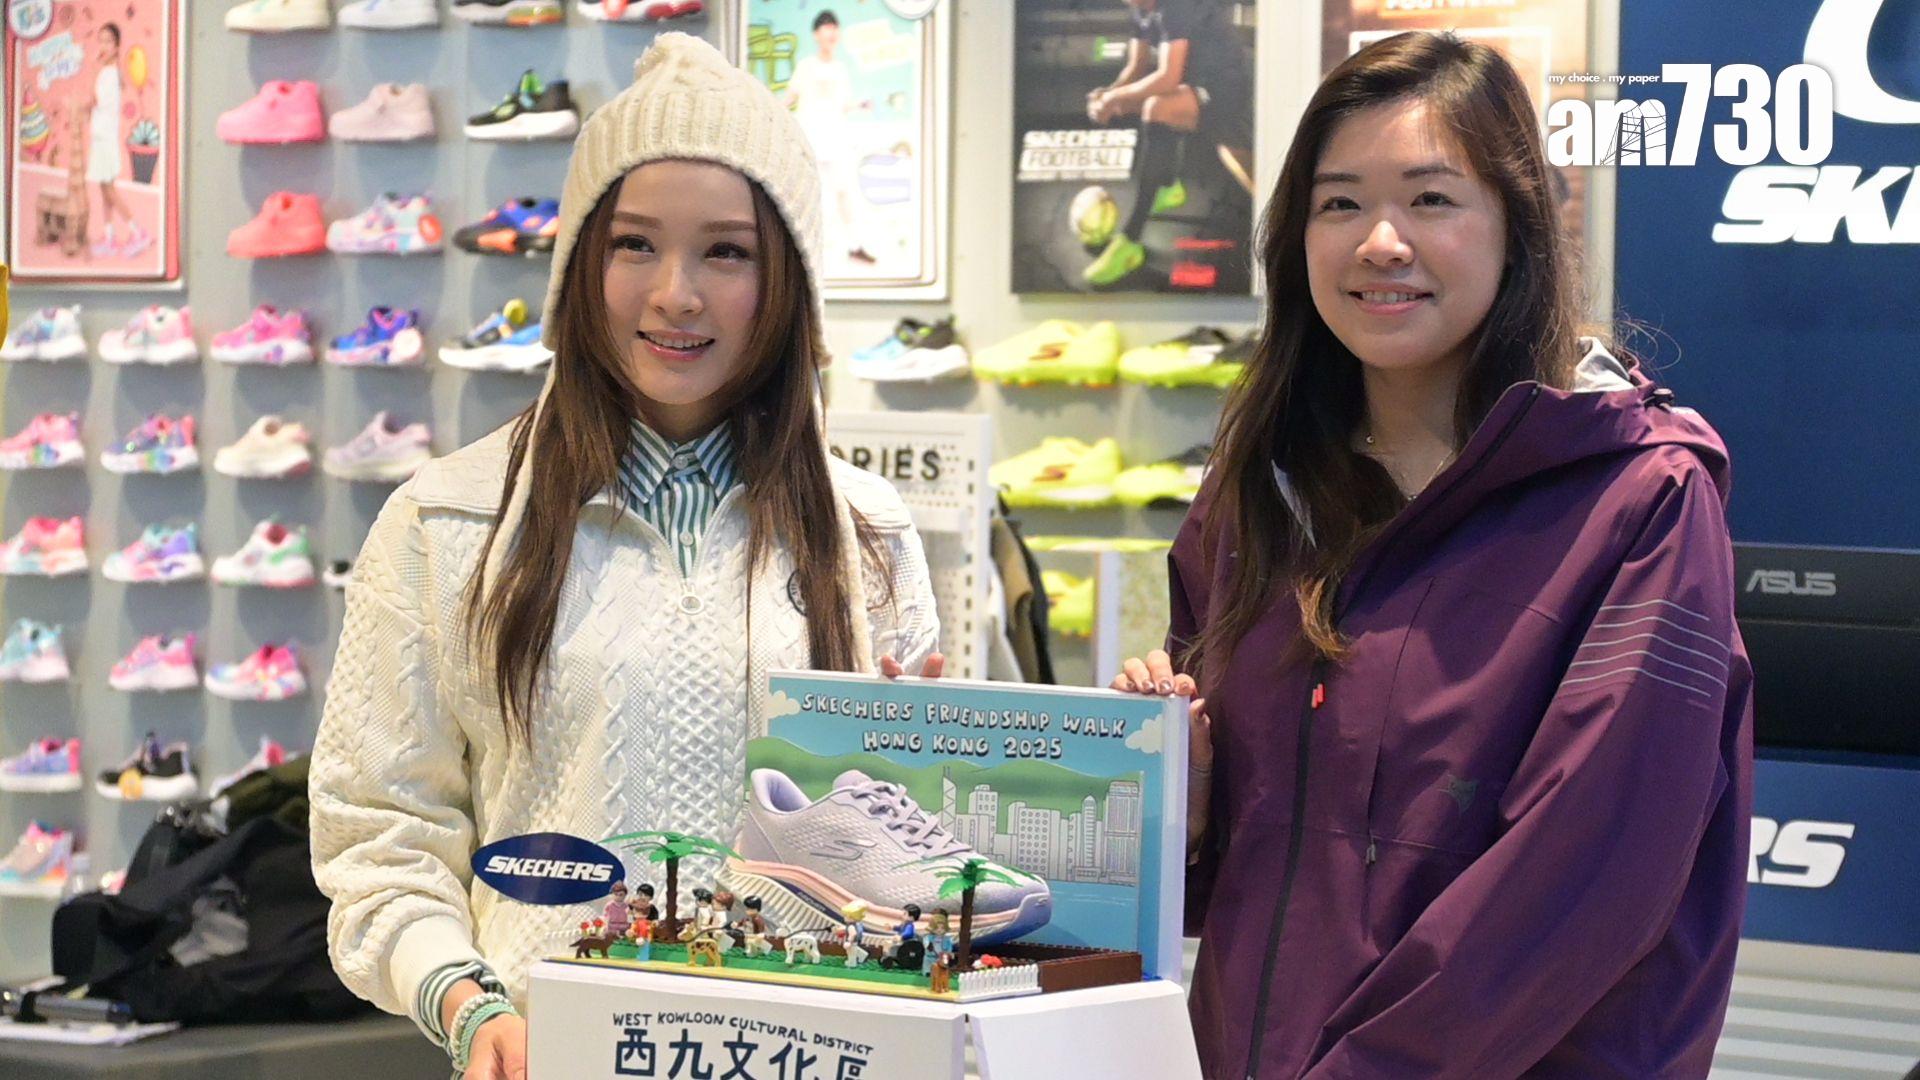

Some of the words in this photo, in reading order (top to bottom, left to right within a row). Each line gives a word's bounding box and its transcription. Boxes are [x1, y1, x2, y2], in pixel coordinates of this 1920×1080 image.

[1711, 165, 1920, 244] SK
[1746, 569, 1837, 597] ASUS
[802, 692, 913, 721] SKECHERS
[925, 703, 1050, 732] FRIENDSHIP
[1062, 713, 1126, 738] WALK
[862, 730, 922, 753] HONG
[932, 732, 990, 757] KONG
[1004, 736, 1063, 759] 2025
[484, 855, 614, 882] SKECHERS
[612, 1013, 652, 1026] WEST
[657, 1012, 725, 1025] KOWLOON
[729, 1016, 807, 1042] CULTURAL
[813, 1033, 874, 1055] DISTRICT
